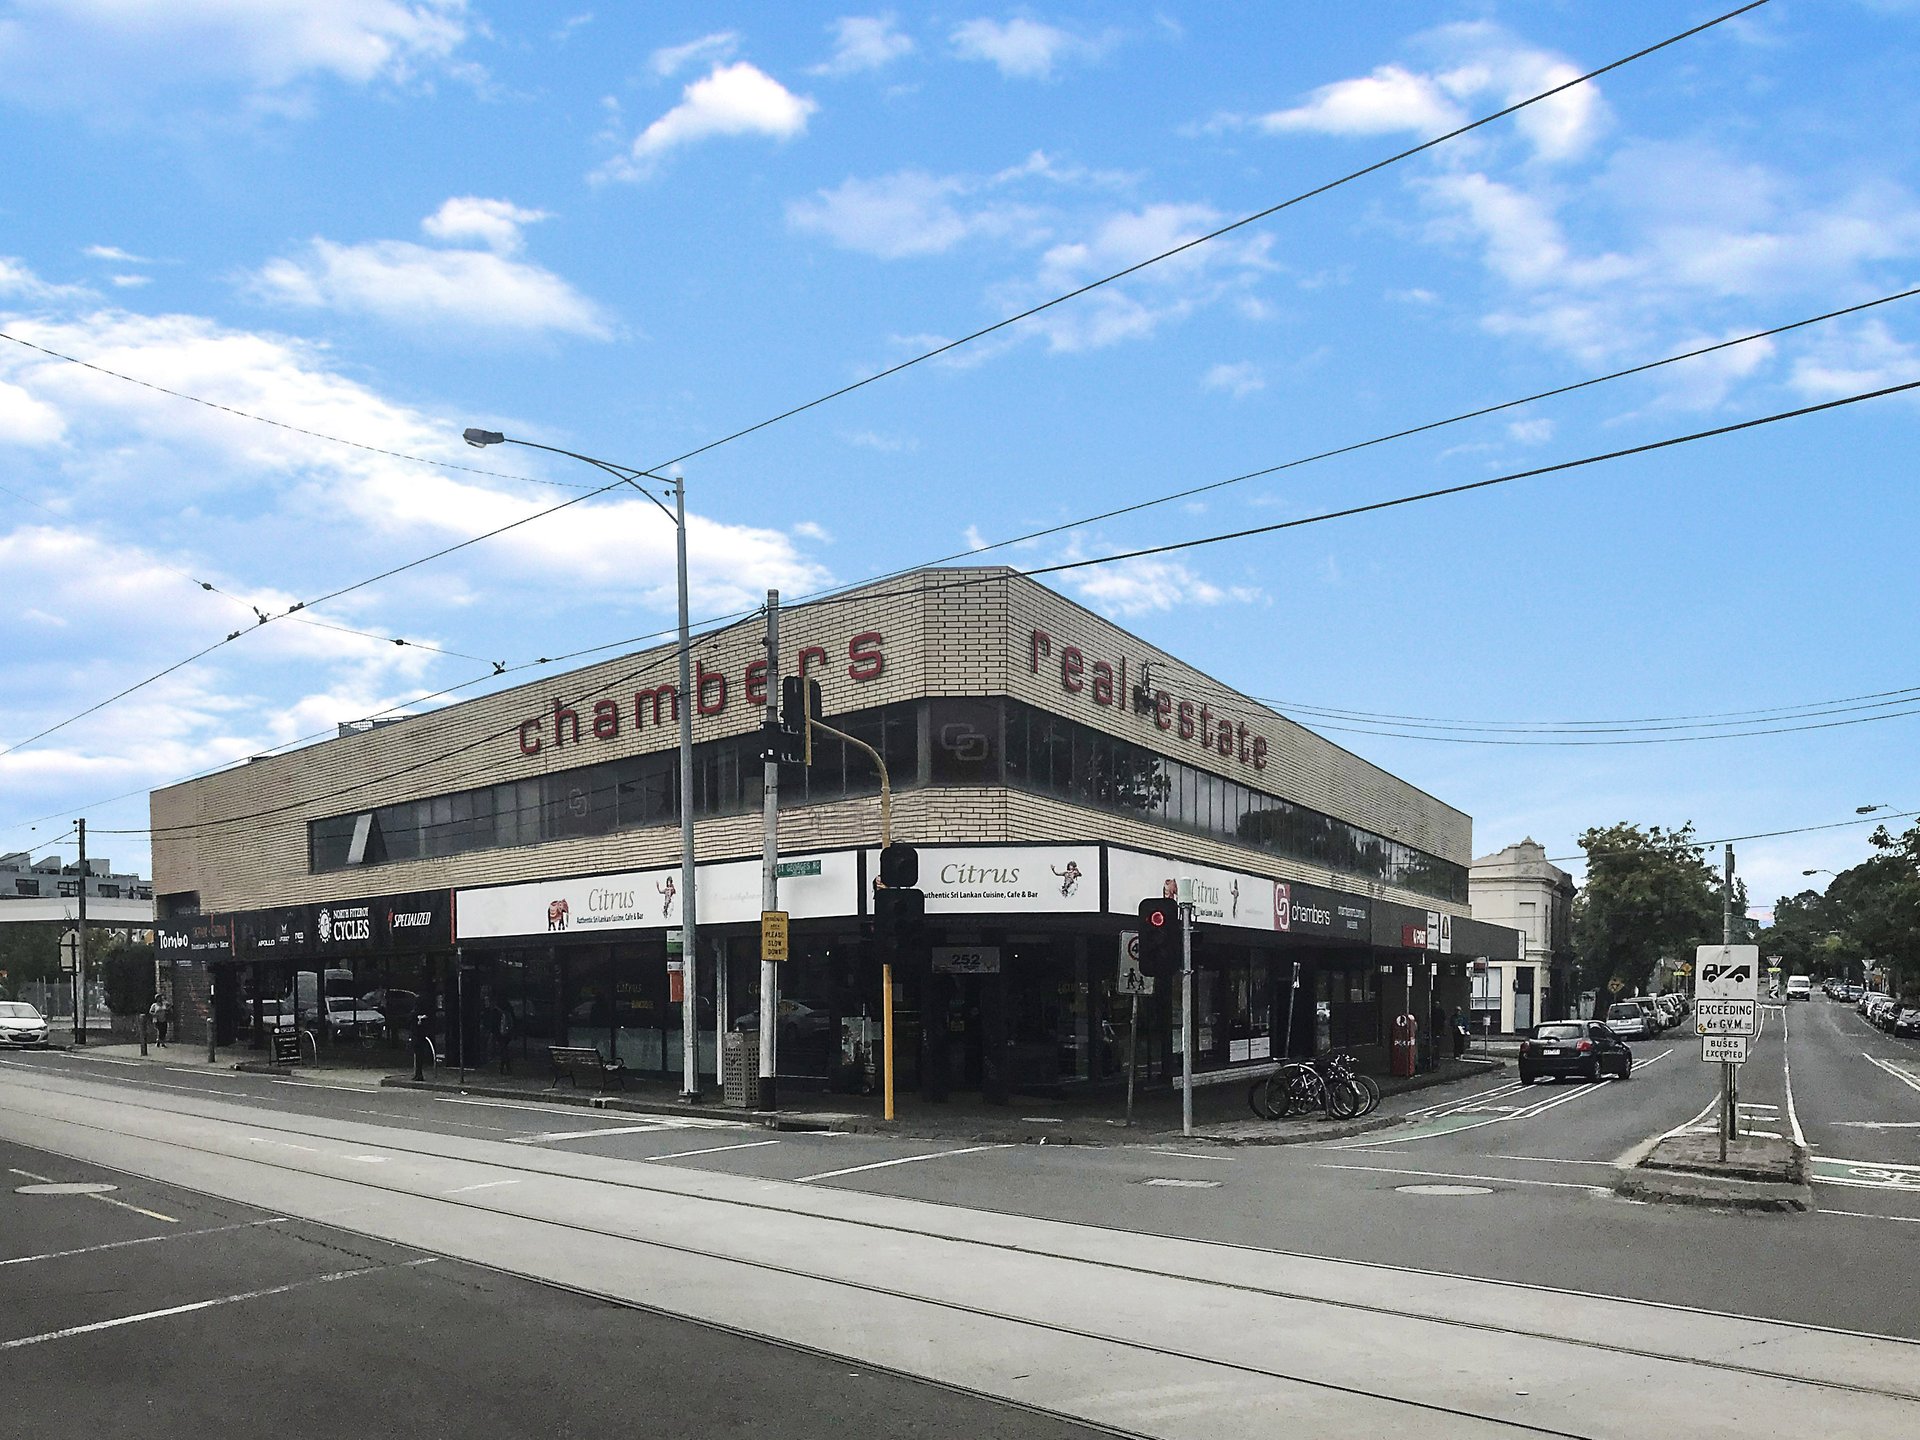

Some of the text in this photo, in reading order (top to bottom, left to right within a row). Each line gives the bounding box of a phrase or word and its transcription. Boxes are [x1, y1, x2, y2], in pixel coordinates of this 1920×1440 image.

[519, 631, 883, 755] chambers
[1033, 629, 1268, 770] real estate
[787, 862, 810, 872] GEORGES
[941, 863, 1020, 884] Citrus
[923, 891, 950, 899] uthentic
[950, 891, 959, 899] Sri
[960, 891, 982, 899] Lankan
[982, 891, 1006, 899] Cuisine,
[1027, 890, 1038, 898] Bar
[1192, 878, 1219, 905] Citrus
[588, 887, 635, 912] Citrus
[333, 906, 369, 919] NORTH FITZROY
[393, 911, 432, 928] SPECIALIZED
[1291, 900, 1331, 925] chambers
[333, 920, 370, 941] CYCLES
[765, 931, 784, 939] PLEASE
[157, 930, 189, 949] Tombo
[258, 939, 276, 947] APOLLO
[951, 954, 981, 966] 252
[1699, 1005, 1752, 1016] EXCEEDING
[1710, 1040, 1739, 1048] BUSES
[1705, 1050, 1743, 1059] EXCEPTED
